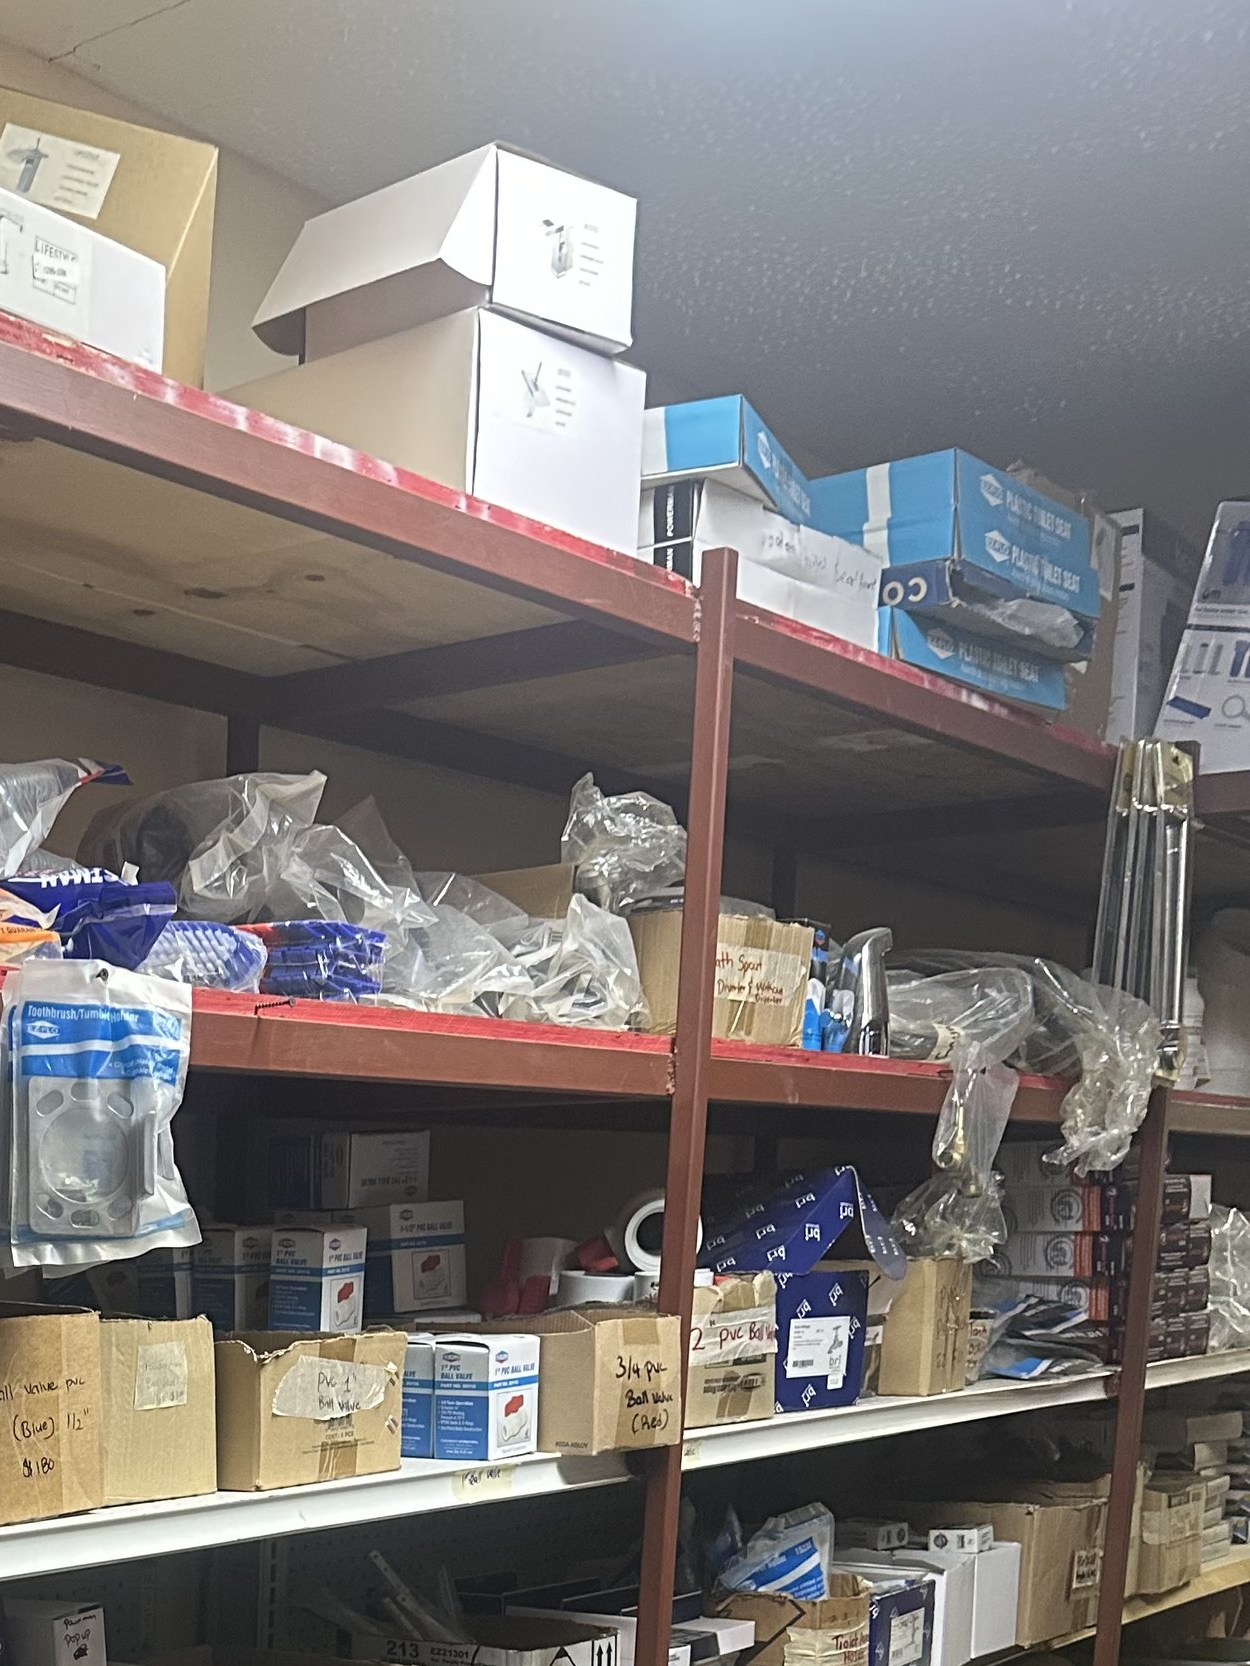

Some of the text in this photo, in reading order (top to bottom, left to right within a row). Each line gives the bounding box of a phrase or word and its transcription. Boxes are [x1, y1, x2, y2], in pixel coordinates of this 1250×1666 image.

[1006, 491, 1032, 520] PLASTIC
[1054, 517, 1072, 539] SEAT
[1011, 545, 1039, 575] PLASTIC
[1063, 572, 1081, 593] SEAT
[1018, 661, 1039, 683] SEAT
[449, 1364, 460, 1372] PVC
[501, 1367, 510, 1375] PVC
[511, 1364, 521, 1373] BALL
[523, 1362, 535, 1372] VALVE
[616, 1356, 640, 1379] 3/4
[626, 1389, 648, 1408] Ball
[13, 1414, 54, 1441] (Blue)
[632, 1408, 669, 1434] (Red)
[386, 1640, 420, 1657] 213
